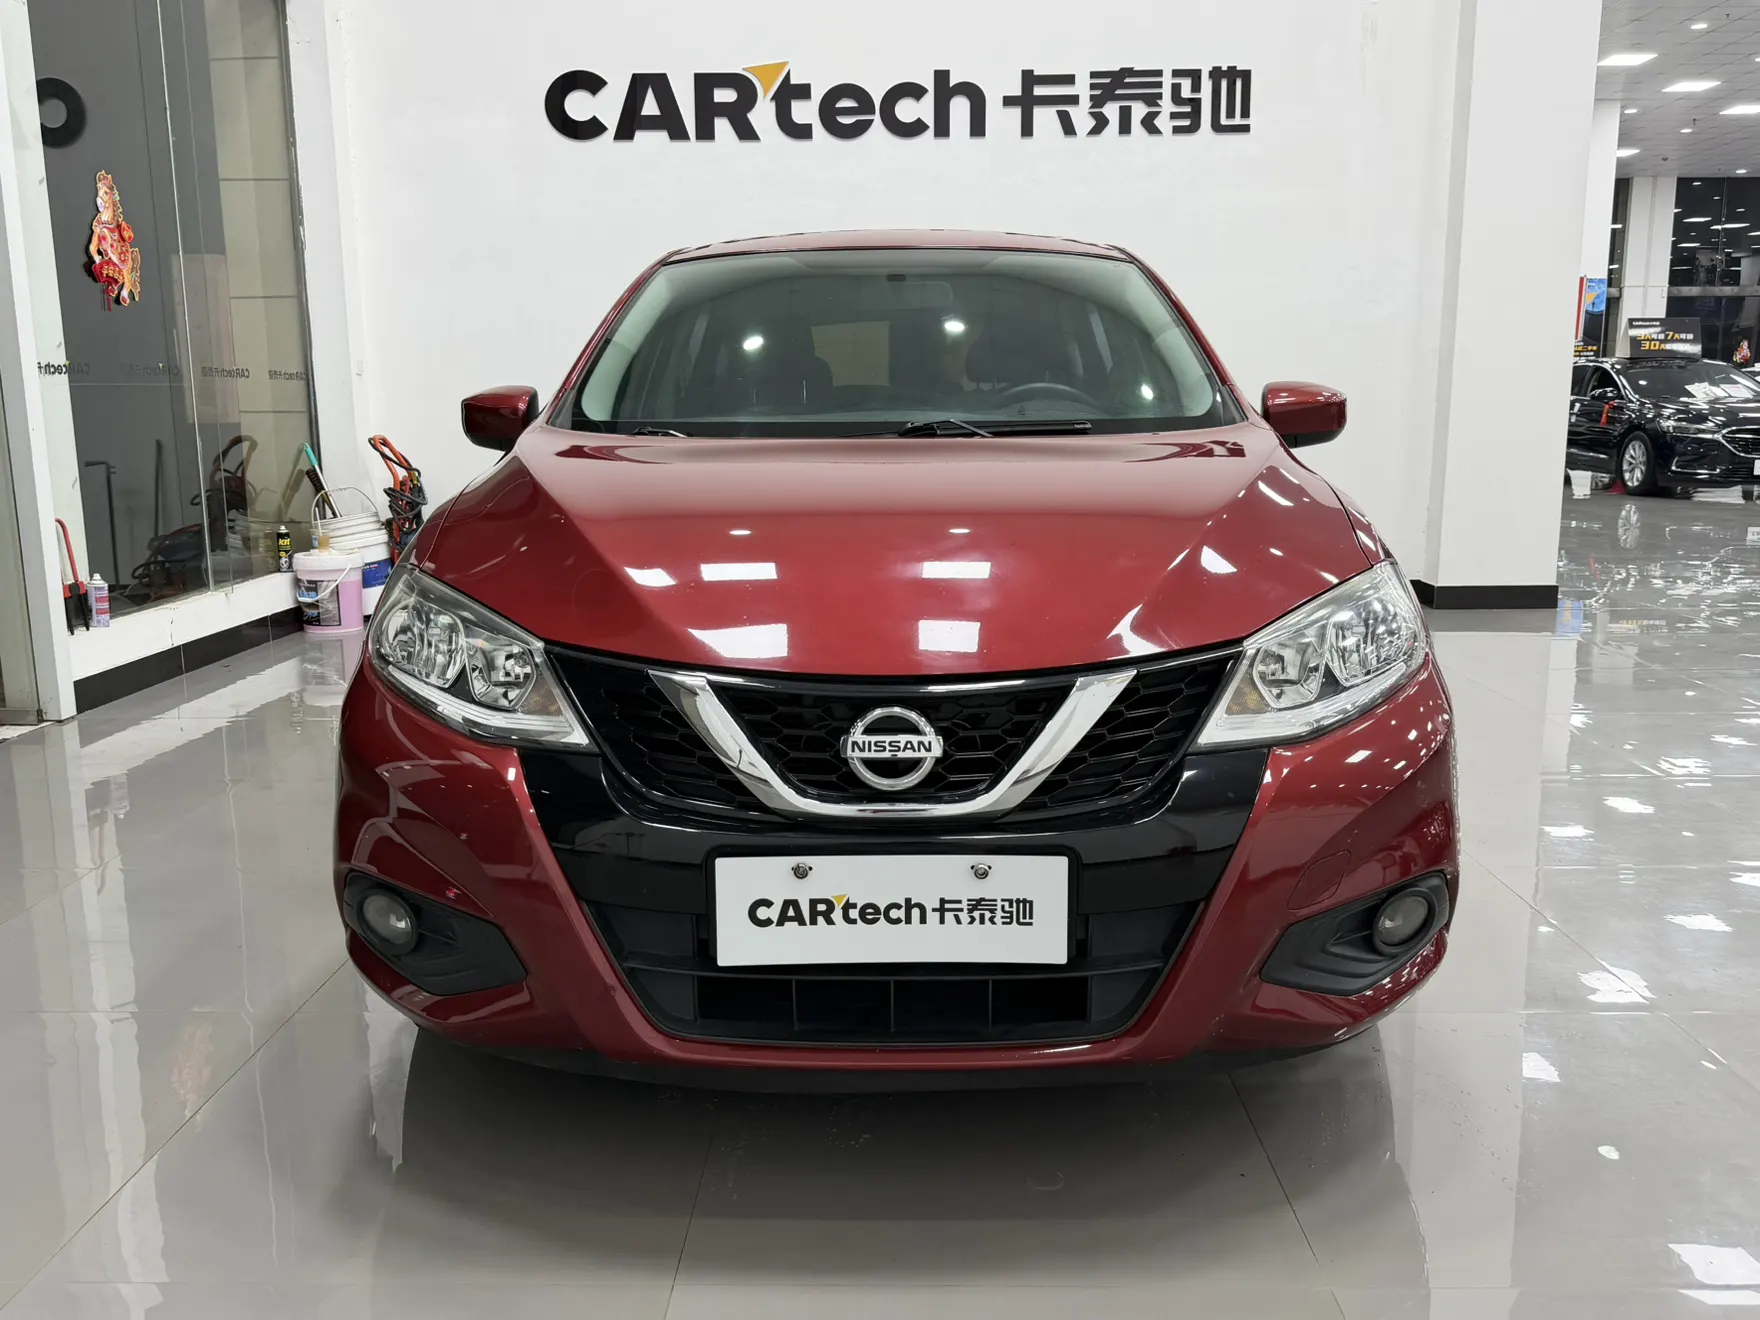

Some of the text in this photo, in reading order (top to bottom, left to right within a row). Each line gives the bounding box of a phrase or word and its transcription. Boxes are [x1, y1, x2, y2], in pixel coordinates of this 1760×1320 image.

[545, 66, 1252, 141] CARtech 卡泰驰
[851, 740, 932, 753] NISSAN
[748, 896, 1034, 928] CARtech 卡泰驰
